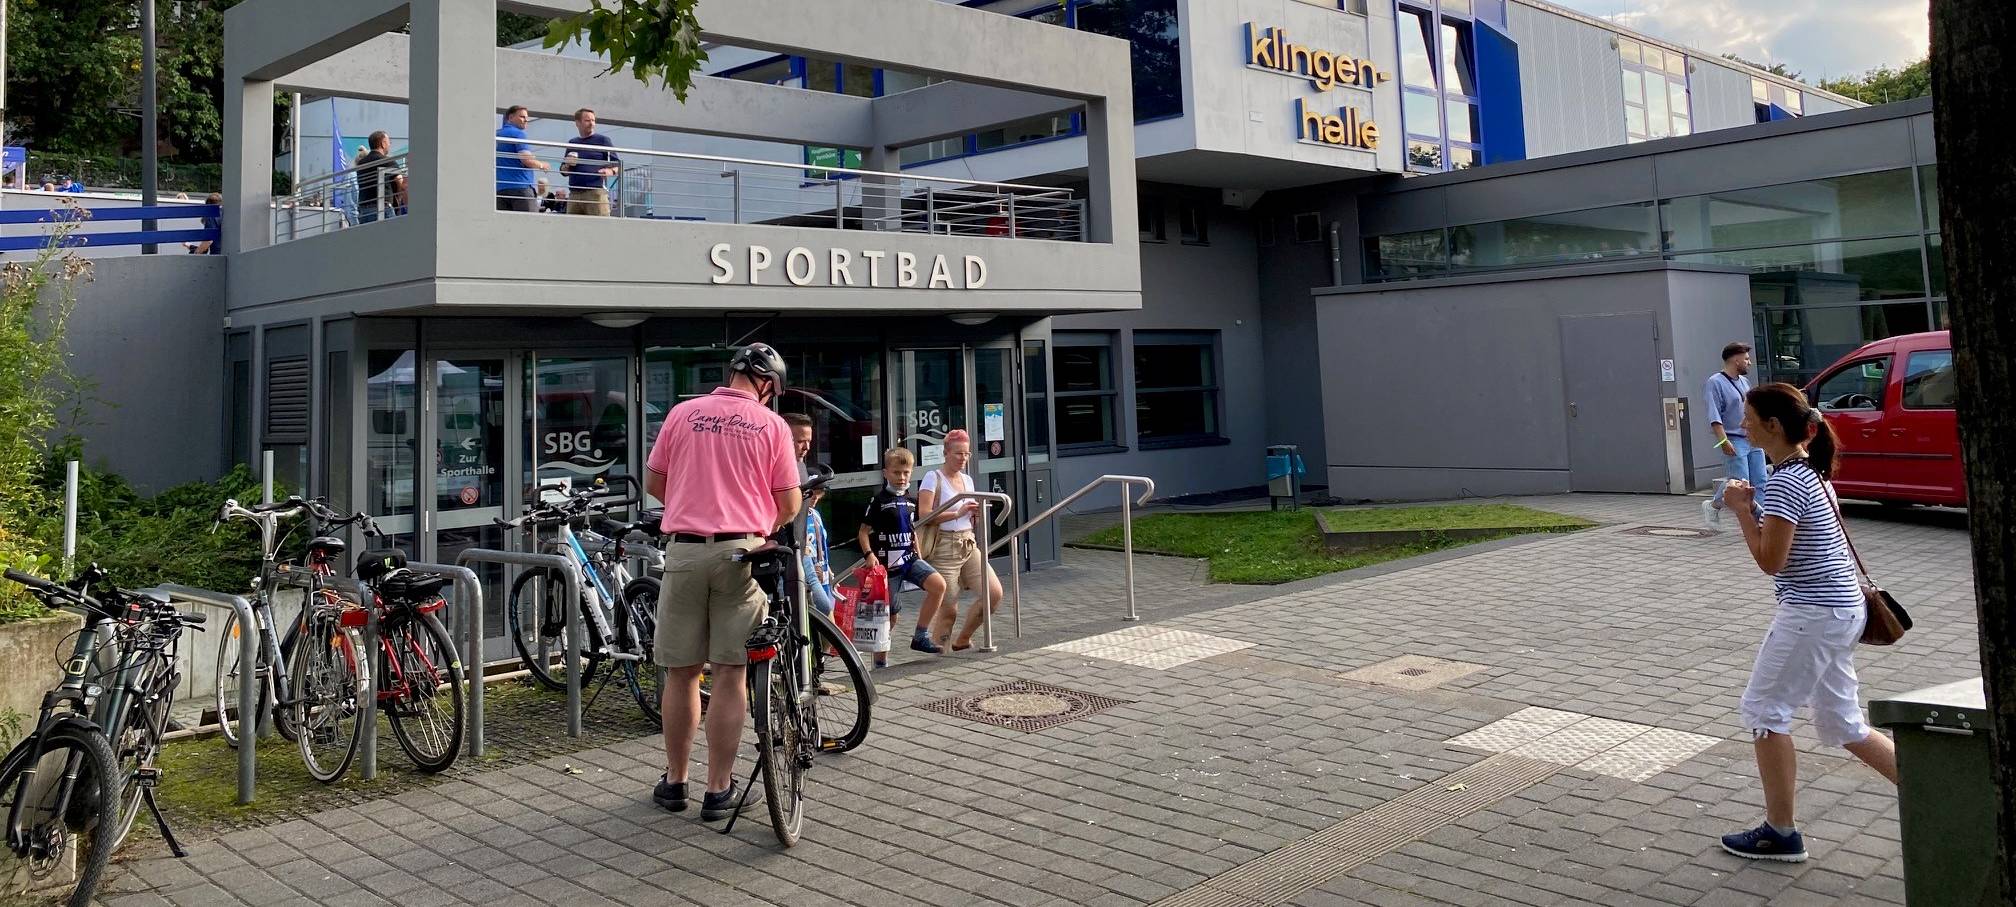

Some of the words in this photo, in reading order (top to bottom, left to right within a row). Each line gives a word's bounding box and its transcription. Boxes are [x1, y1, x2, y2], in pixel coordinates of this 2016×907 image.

[1245, 21, 1392, 92] klingen-
[1295, 97, 1380, 149] halle
[709, 243, 988, 290] SPORTBAD
[687, 409, 725, 424] Camp
[727, 414, 768, 433] David
[692, 422, 722, 434] 25-01
[908, 408, 940, 428] SBG
[544, 430, 591, 454] SBG
[459, 454, 477, 464] Zur
[440, 465, 495, 478] Sporthalle
